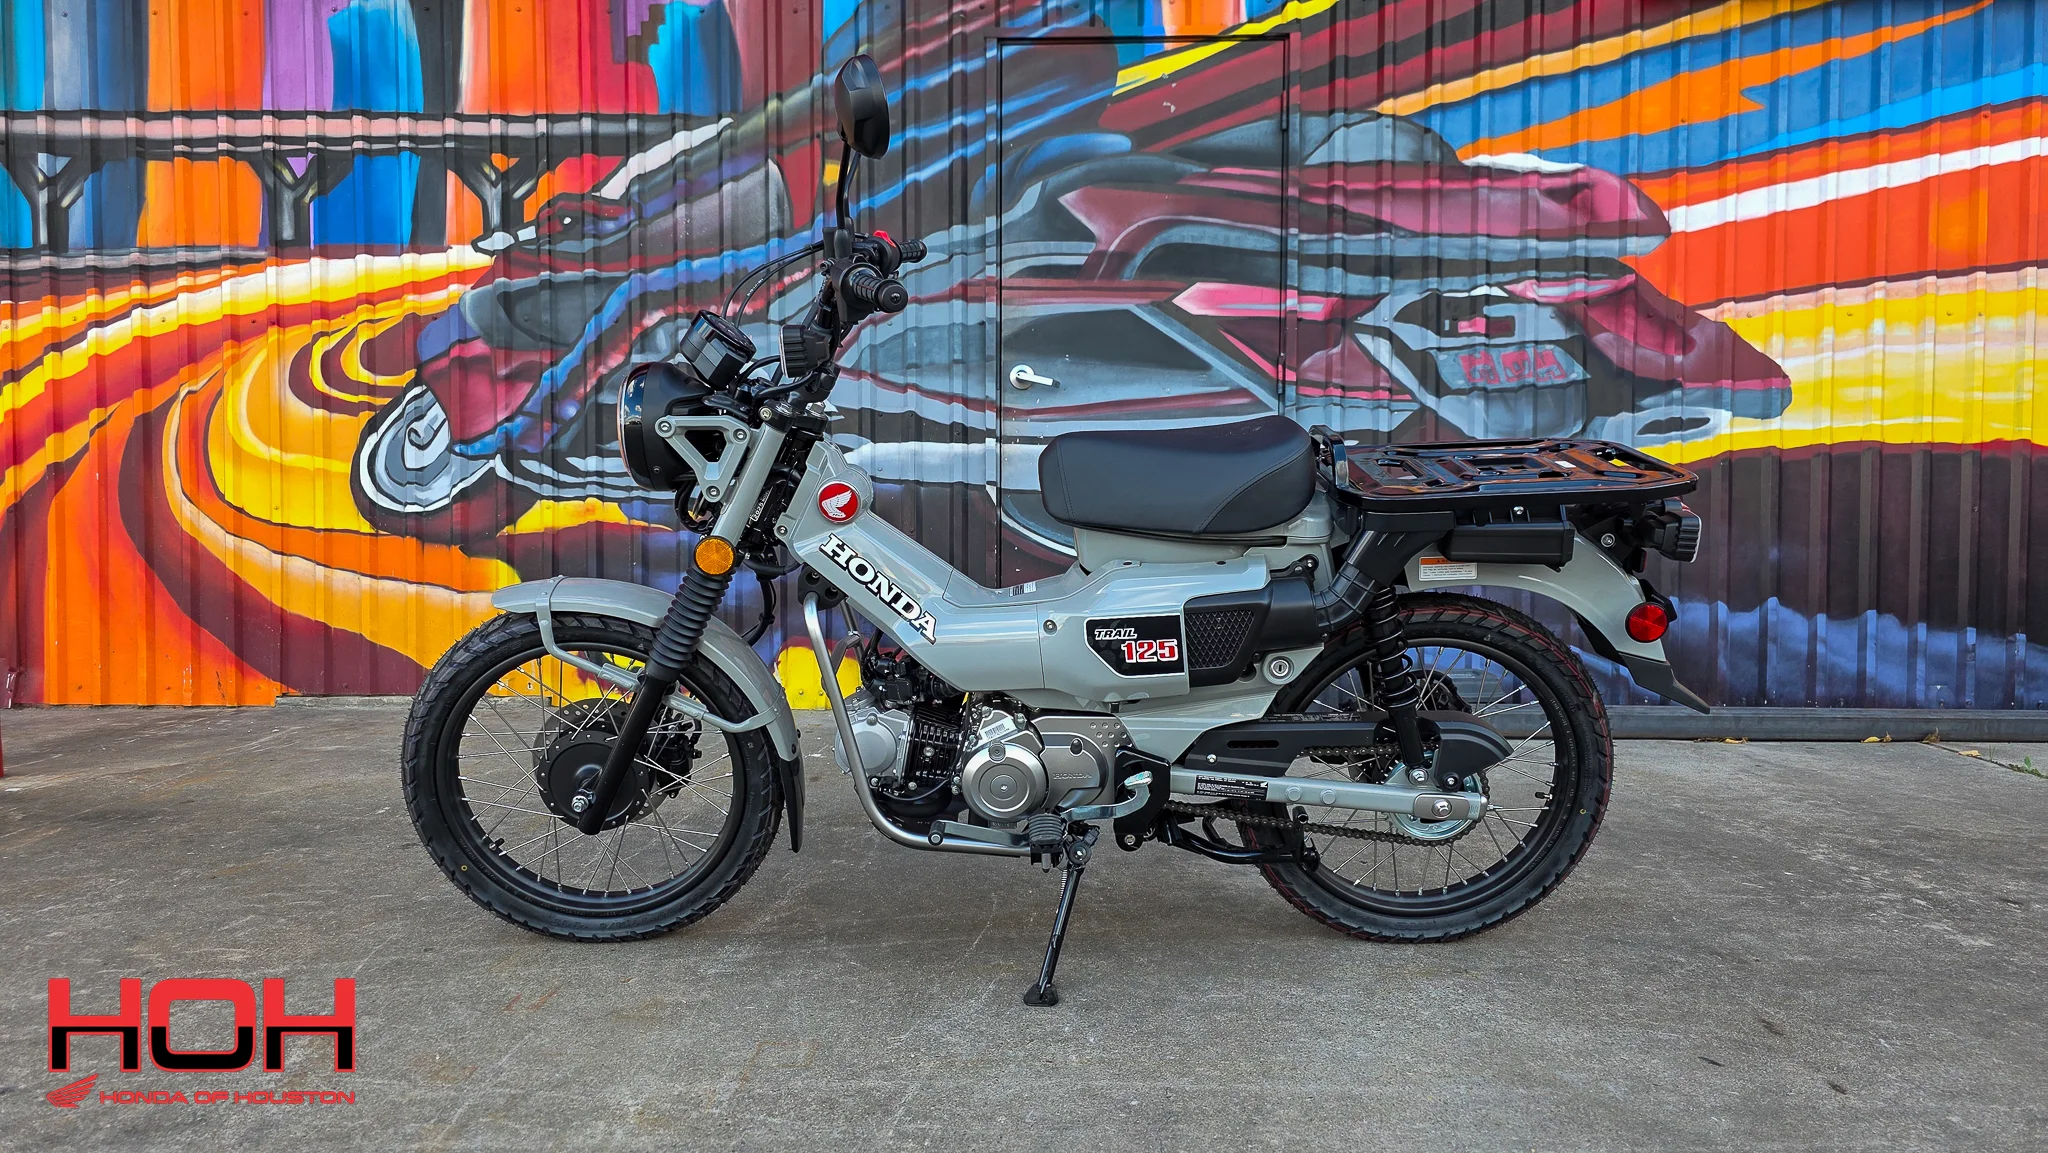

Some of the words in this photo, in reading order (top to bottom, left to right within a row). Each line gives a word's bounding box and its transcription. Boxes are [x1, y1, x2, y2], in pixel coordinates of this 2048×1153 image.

[819, 533, 936, 645] HONDA
[1094, 628, 1137, 640] TRAIL
[1121, 639, 1178, 663] 125
